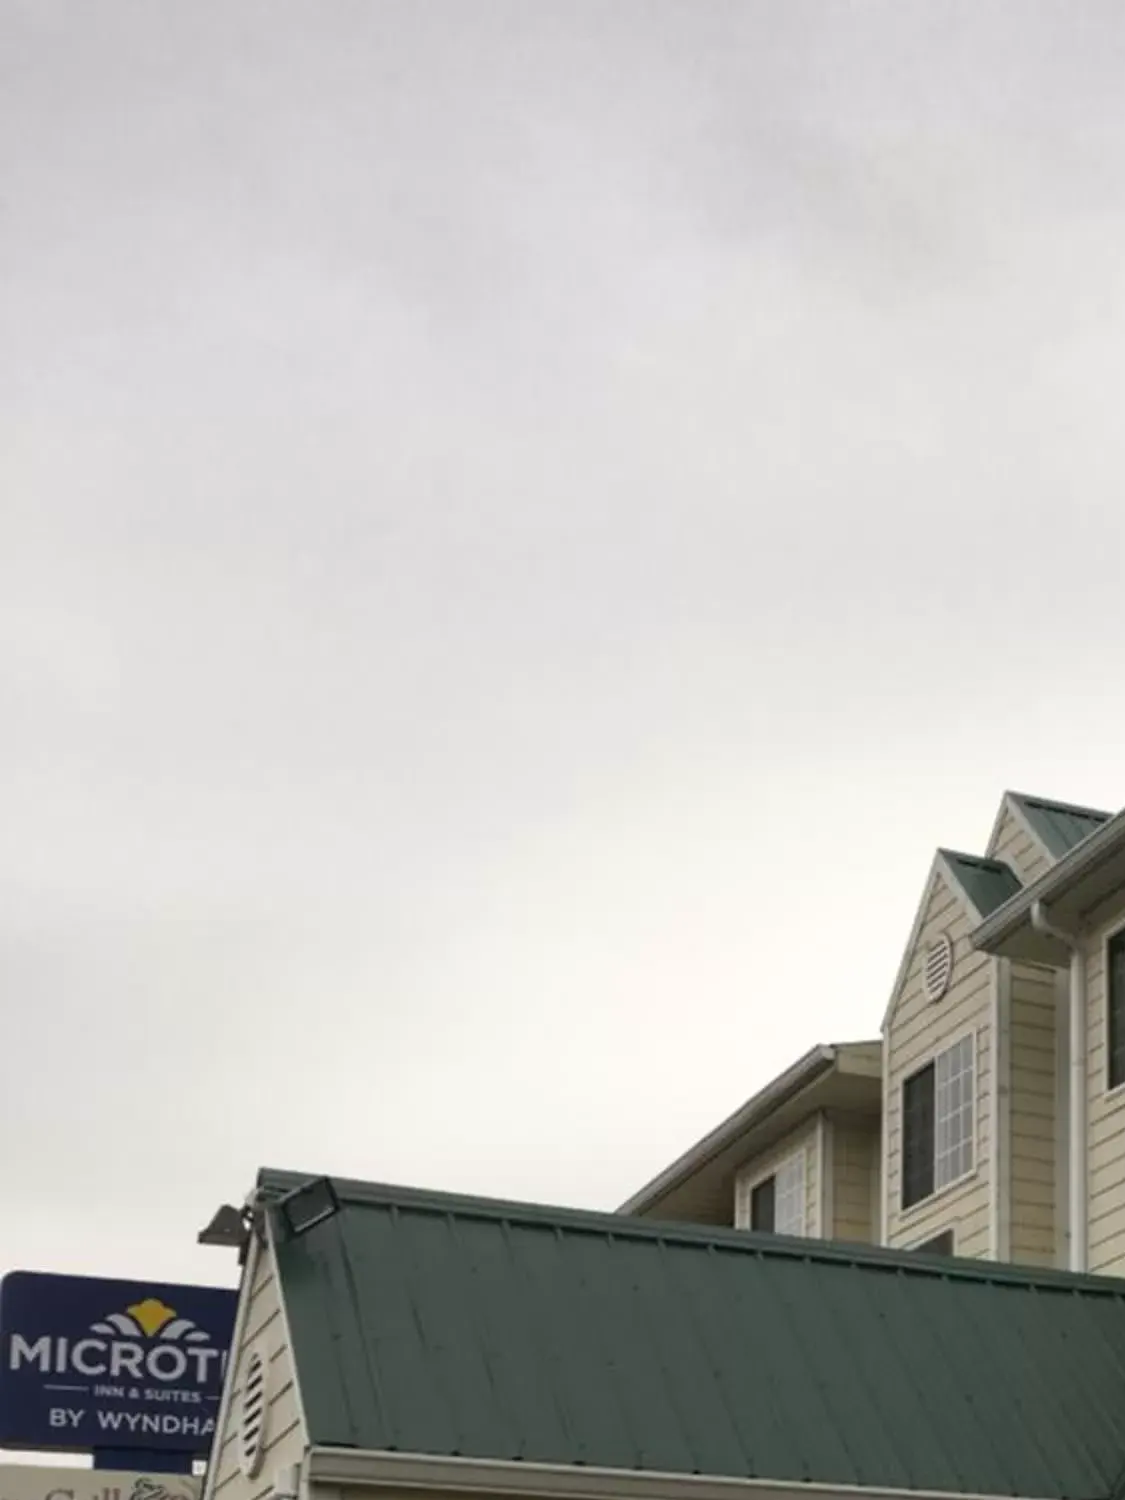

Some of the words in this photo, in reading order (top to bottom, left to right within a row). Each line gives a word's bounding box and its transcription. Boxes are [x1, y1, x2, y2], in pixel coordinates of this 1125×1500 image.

[9, 1333, 227, 1384] MICROT
[94, 1384, 124, 1398] INN
[128, 1386, 140, 1399] &
[143, 1388, 201, 1404] SUITES
[49, 1408, 84, 1428] BY
